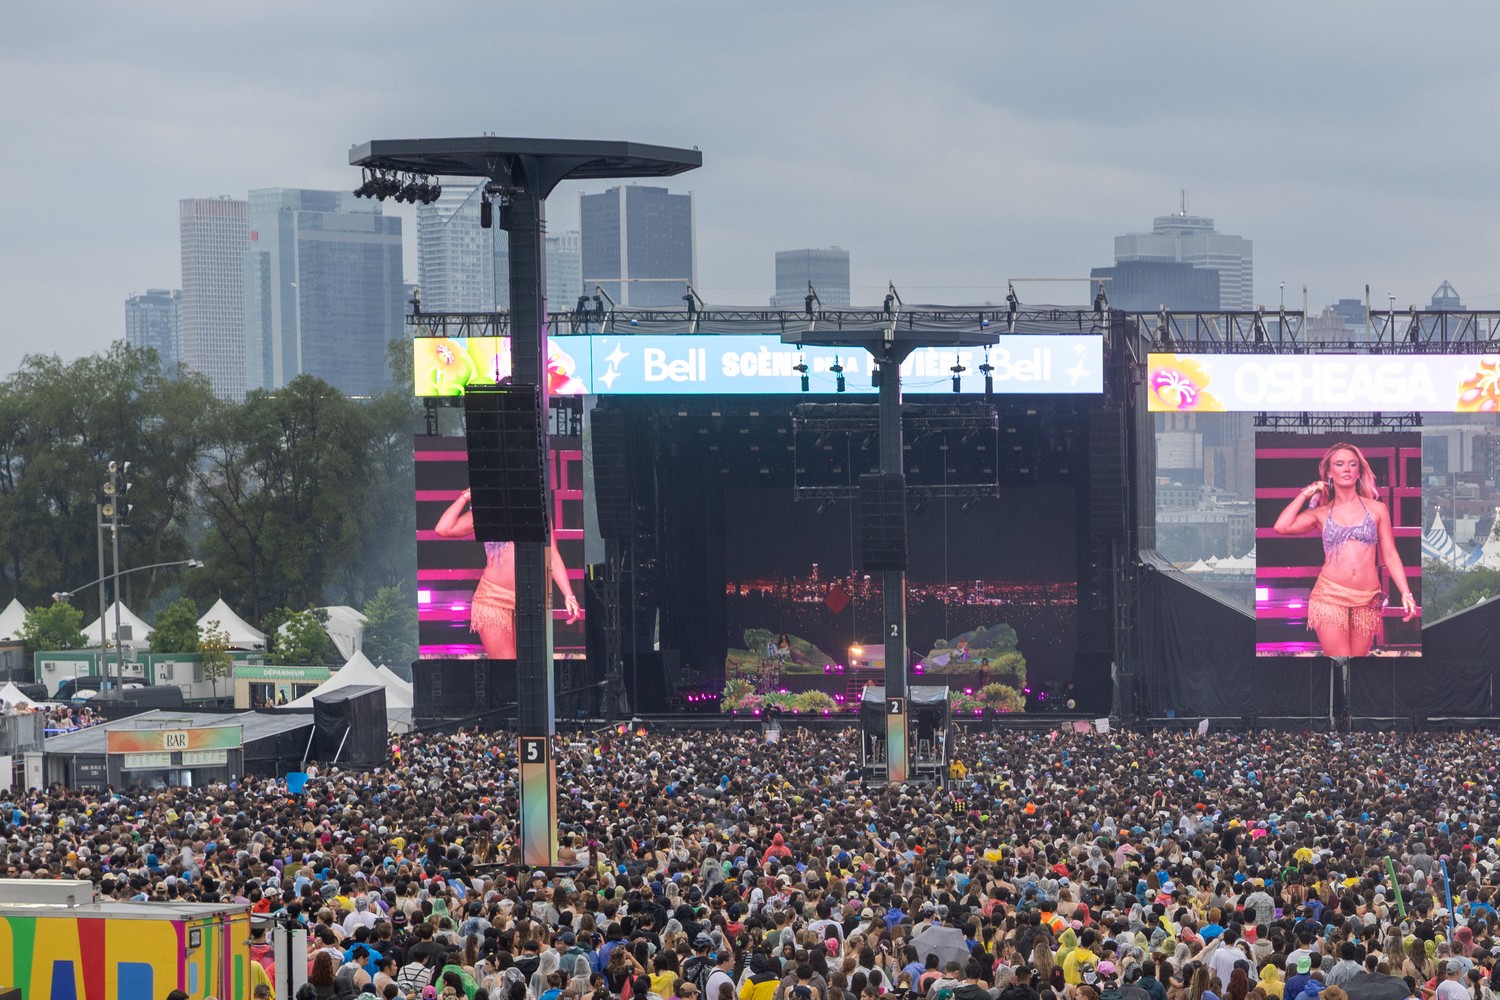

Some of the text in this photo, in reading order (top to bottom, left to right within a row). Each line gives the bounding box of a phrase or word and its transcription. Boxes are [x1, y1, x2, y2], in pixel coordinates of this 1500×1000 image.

[644, 347, 706, 381] Bell
[722, 345, 807, 377] SCÈNE
[989, 347, 1051, 381] Bell
[1233, 362, 1439, 404] OSHEAGA
[891, 624, 898, 636] 2
[263, 669, 305, 677] DÉPANNEUR
[891, 701, 898, 713] 2
[167, 734, 186, 747] BAR
[527, 742, 538, 760] 5
